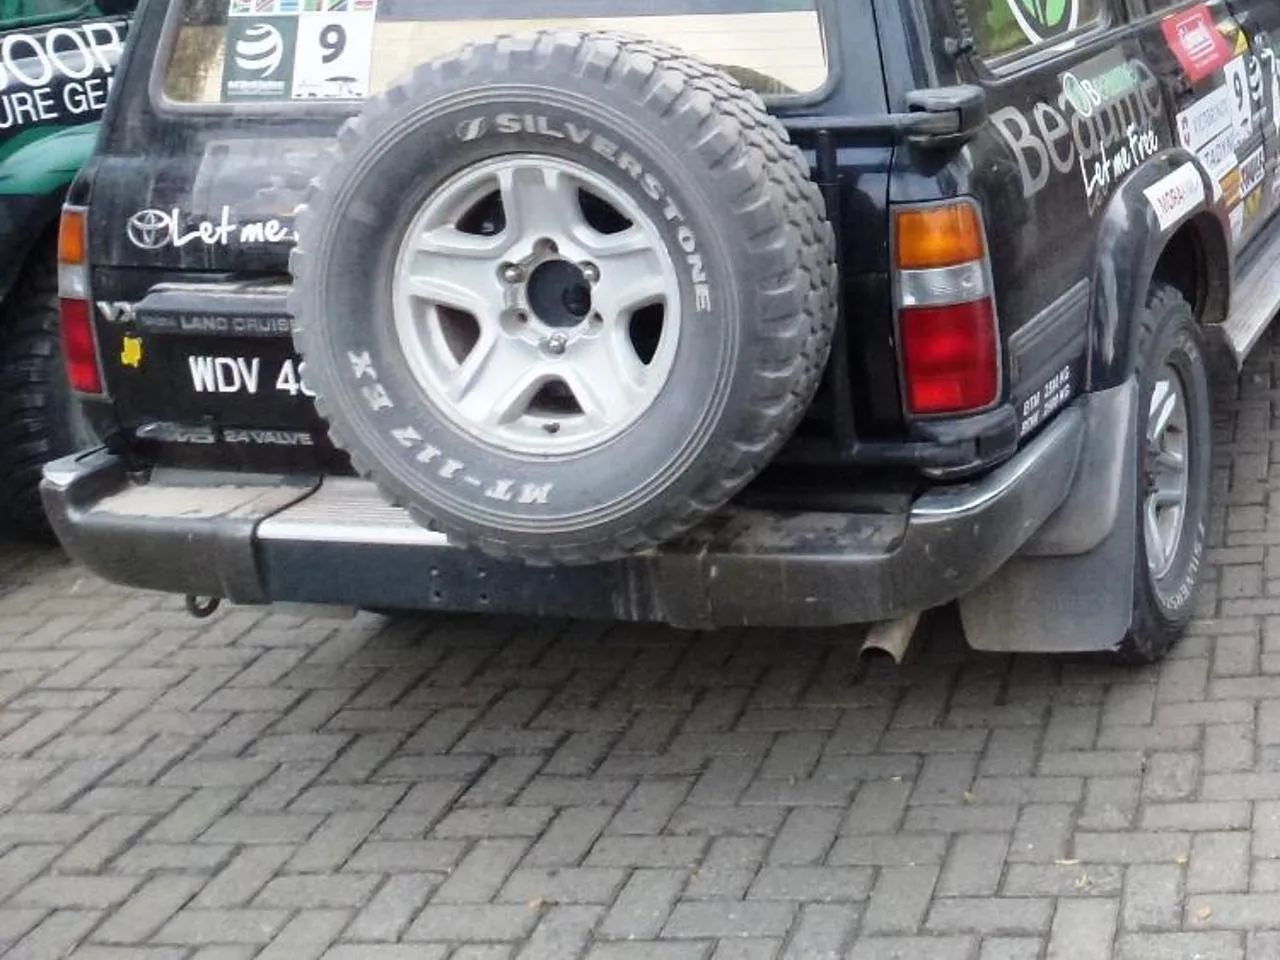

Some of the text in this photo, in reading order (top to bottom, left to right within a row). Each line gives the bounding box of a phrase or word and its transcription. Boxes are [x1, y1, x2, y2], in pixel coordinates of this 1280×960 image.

[319, 24, 347, 64] 9
[63, 77, 114, 114] GE
[171, 204, 236, 247] Let
[495, 112, 711, 312] SILVERSTONE
[180, 314, 229, 331] LAND
[188, 355, 260, 394] WDV
[251, 432, 314, 445] VALVE
